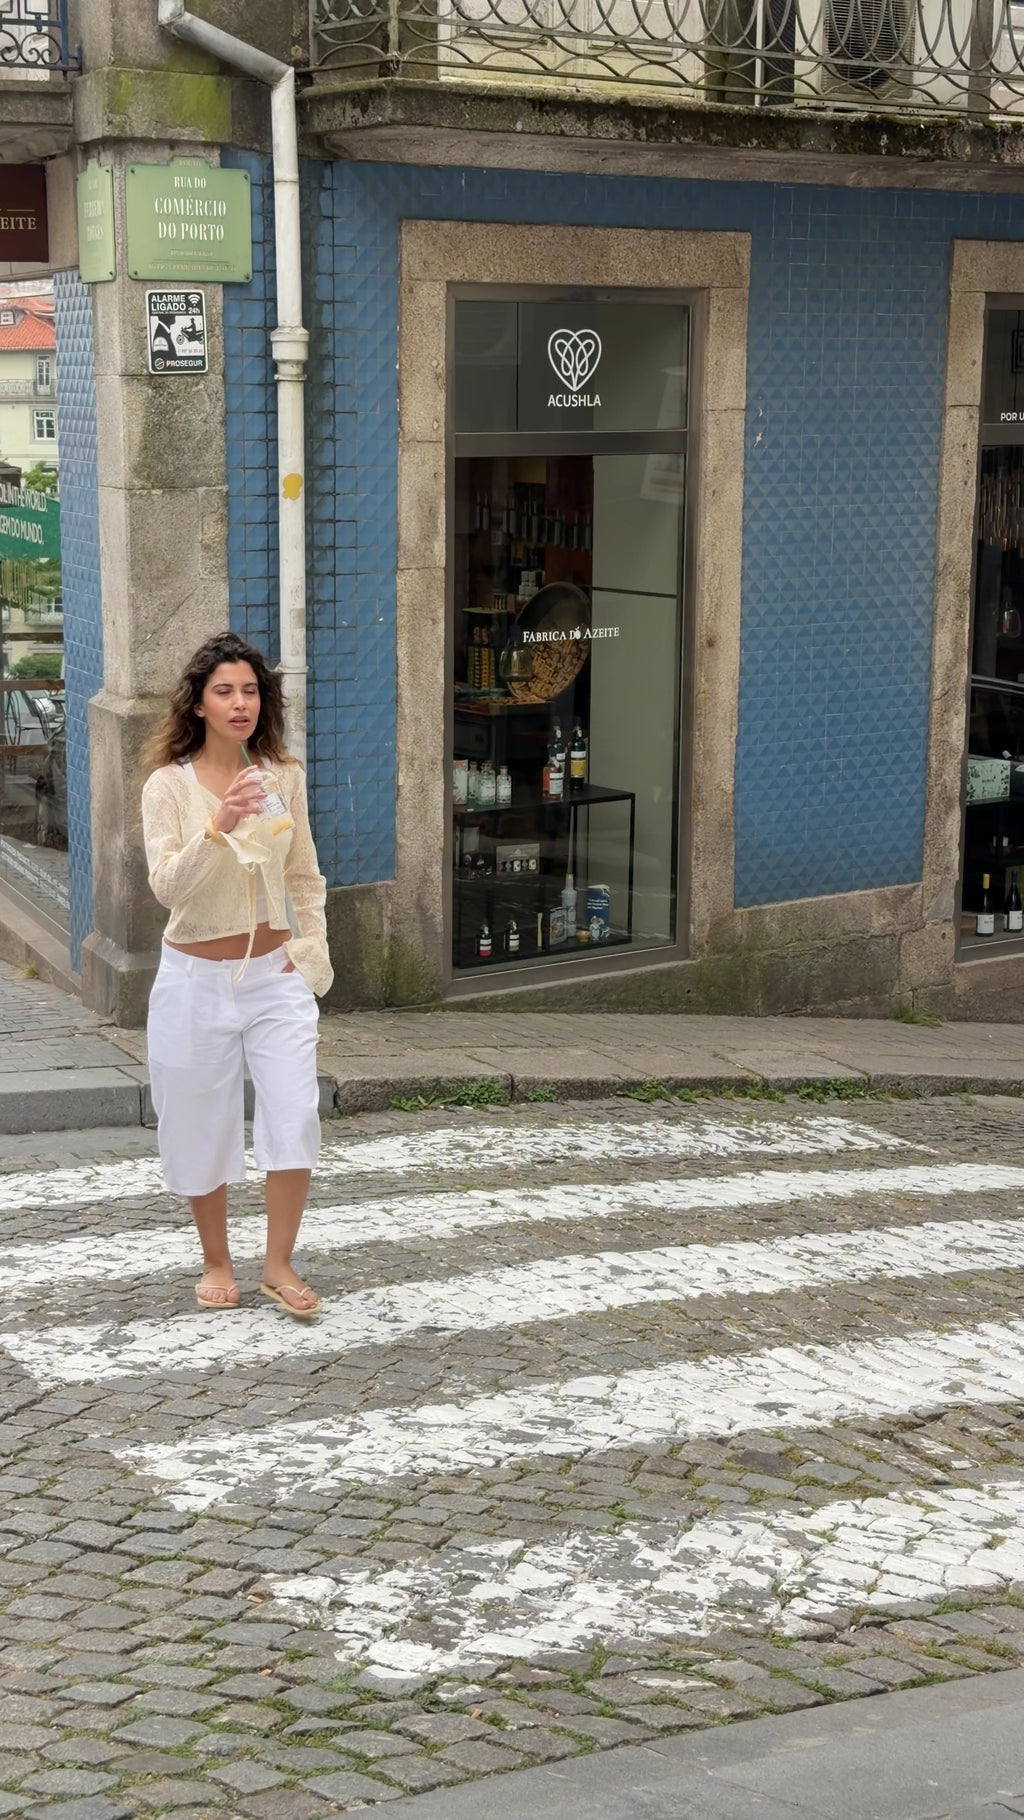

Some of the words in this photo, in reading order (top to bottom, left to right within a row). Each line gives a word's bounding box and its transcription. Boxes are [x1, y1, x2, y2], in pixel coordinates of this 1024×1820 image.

[174, 176, 192, 189] RUA
[194, 177, 207, 189] DO
[154, 194, 227, 217] COMÉRCIO
[158, 221, 177, 239] DO
[181, 222, 224, 241] PORTO
[151, 294, 186, 303] ALARME
[151, 302, 187, 312] LIGADO
[166, 359, 203, 367] PROSEGUR
[547, 394, 602, 407] ACUSHLA
[1001, 412, 1017, 421] POR
[522, 631, 567, 643] FABRICA
[583, 627, 620, 639] AZEITE
